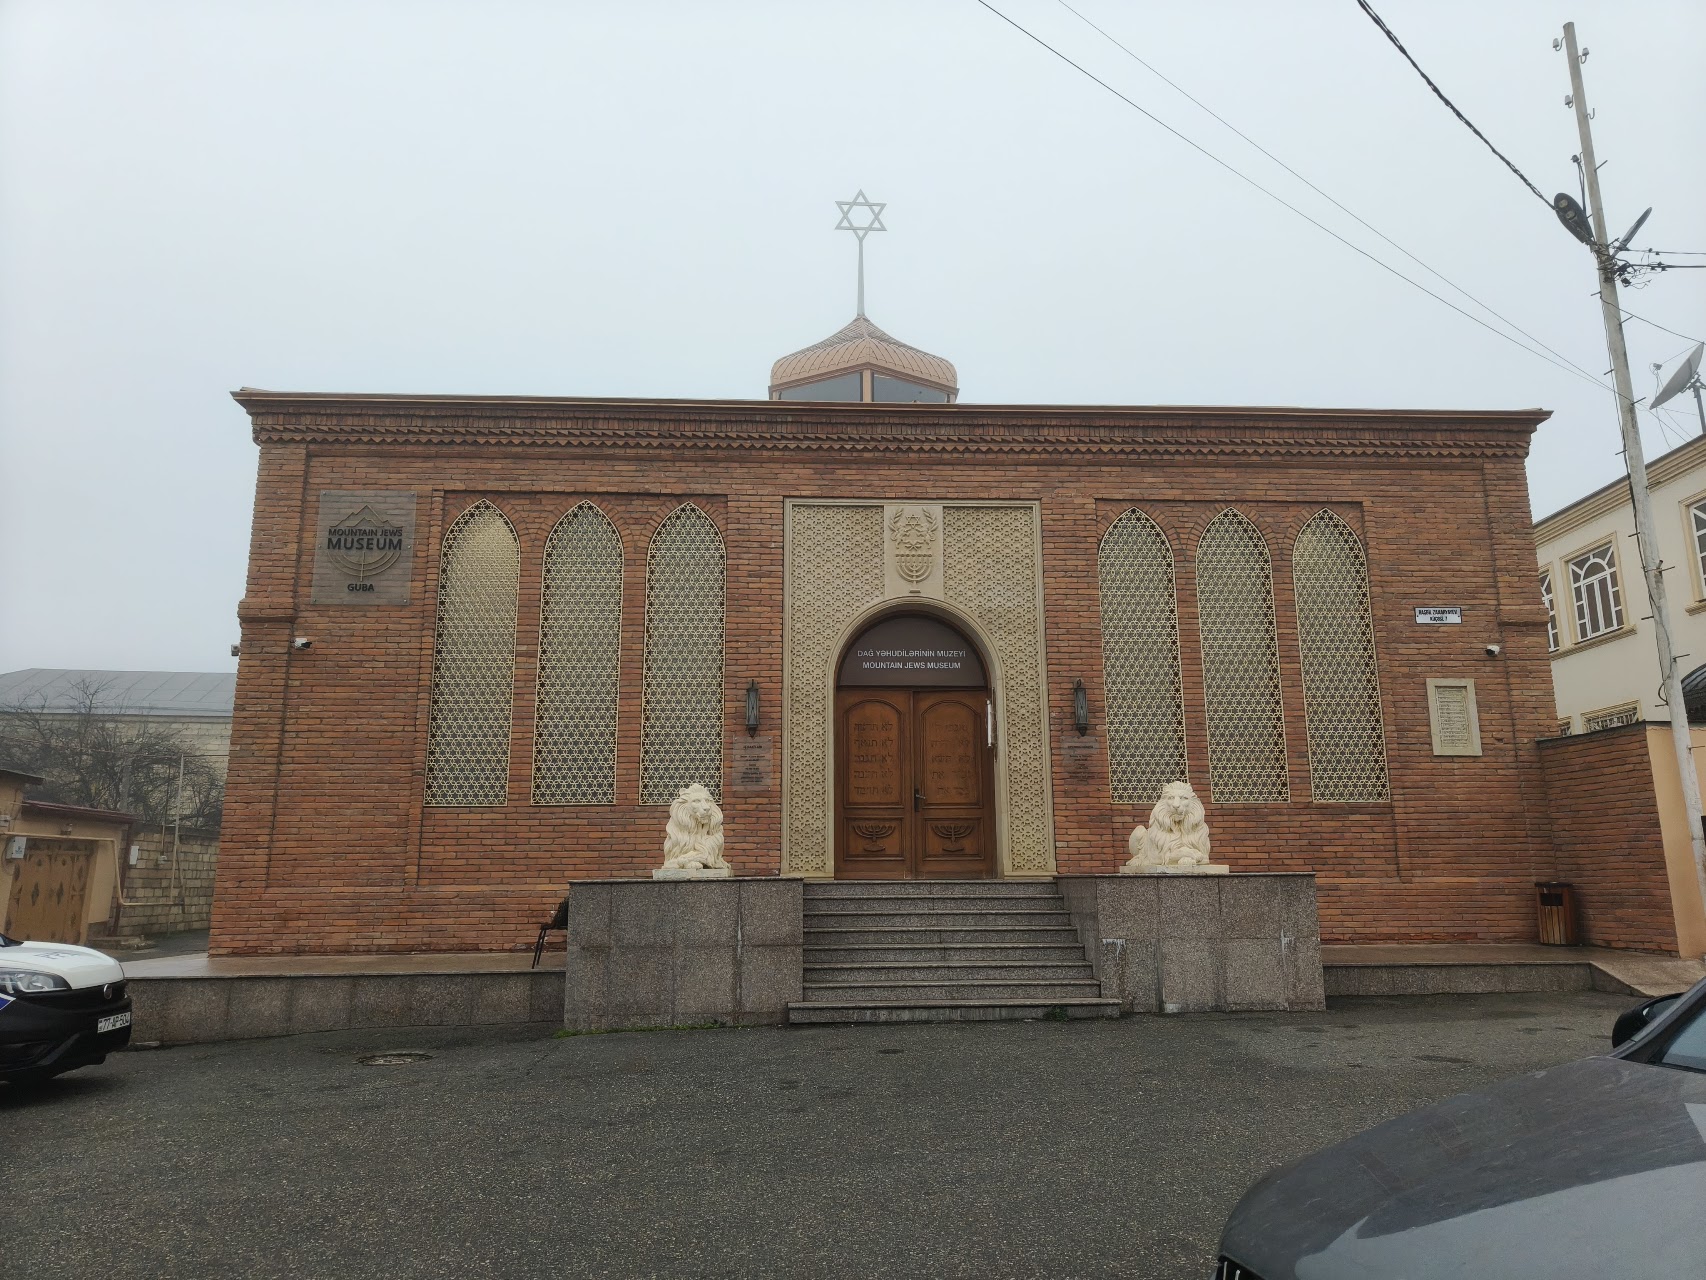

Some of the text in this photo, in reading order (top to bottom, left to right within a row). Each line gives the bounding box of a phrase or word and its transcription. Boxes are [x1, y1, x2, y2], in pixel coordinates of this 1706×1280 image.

[328, 528, 403, 537] MOUNTAIN JEWS
[327, 537, 403, 551] MUSEUM
[347, 583, 375, 592] GUBA
[857, 648, 874, 657] DAĞ
[862, 661, 903, 669] MOUNTAIN
[904, 661, 926, 669] JEWS
